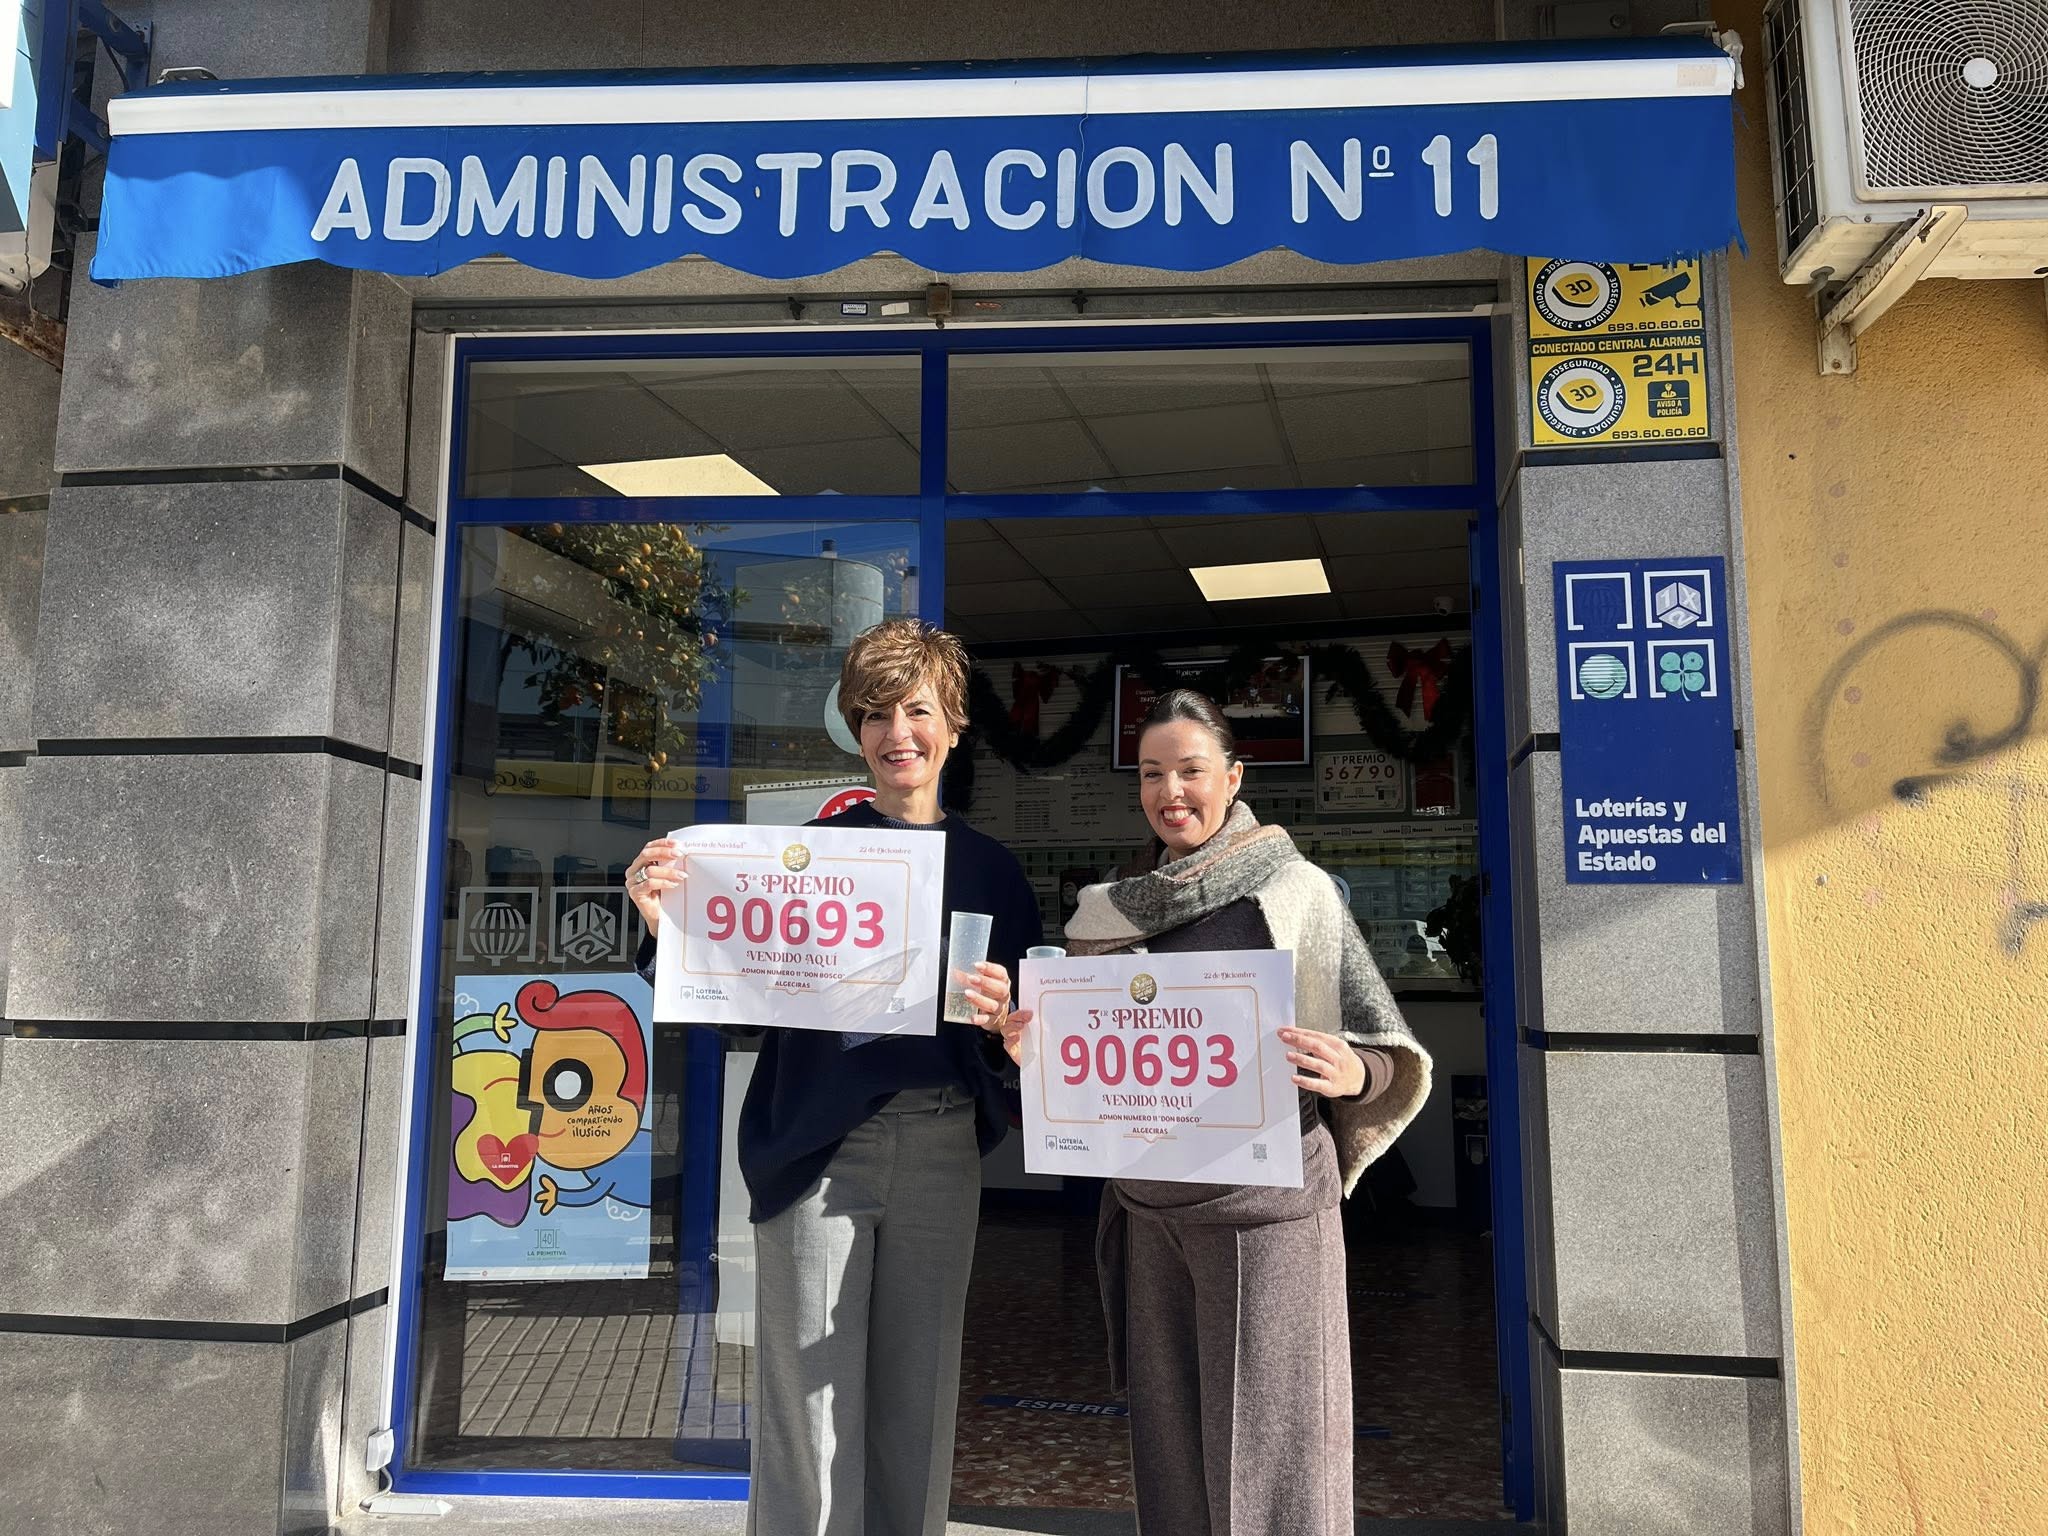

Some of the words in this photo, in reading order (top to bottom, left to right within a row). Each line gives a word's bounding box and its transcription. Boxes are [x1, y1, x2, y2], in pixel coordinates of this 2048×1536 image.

[310, 142, 1234, 242] ADMINISTRACION
[1421, 133, 1499, 220] 11
[1565, 279, 1593, 296] 3D
[1607, 319, 1700, 332] 693.60.60.60
[1532, 341, 1596, 355] CONECTADO
[1598, 338, 1647, 352] CENTRAL
[1650, 335, 1701, 348] ALARMAS
[1549, 359, 1610, 380] 3DSEGURIDAD
[1632, 352, 1699, 377] 24H
[1570, 384, 1597, 401] 3D
[1656, 407, 1683, 416] POLICÍA
[1612, 427, 1706, 440] 693.60.60.60
[1342, 753, 1386, 765] PREMIO
[1576, 796, 1667, 818] Loterías
[1674, 801, 1688, 822] y
[1578, 824, 1684, 849] Apuestas
[1690, 822, 1727, 844] del
[1578, 850, 1657, 872] Estado
[760, 873, 855, 896] PREMIO
[706, 895, 885, 949] 90693
[746, 950, 801, 964] VENDIDO
[805, 951, 837, 968] AQUÍ
[741, 967, 765, 975] ADMON
[766, 969, 794, 977] NUMERO
[696, 987, 723, 996] LOTERÍA
[774, 980, 811, 989] ALGECIRAS
[1112, 1007, 1203, 1030] PREMIO
[1060, 1034, 1239, 1088] 90693
[588, 1104, 614, 1115] AÑOS
[1102, 1094, 1158, 1107] VENDIDO
[1160, 1093, 1193, 1111] AQUÍ
[1132, 1127, 1169, 1135] ALGECIRAS
[1058, 1137, 1084, 1145] LOTERÍA
[1058, 1144, 1091, 1152] NACIONAL
[1014, 1399, 1119, 1416] ESPERE
